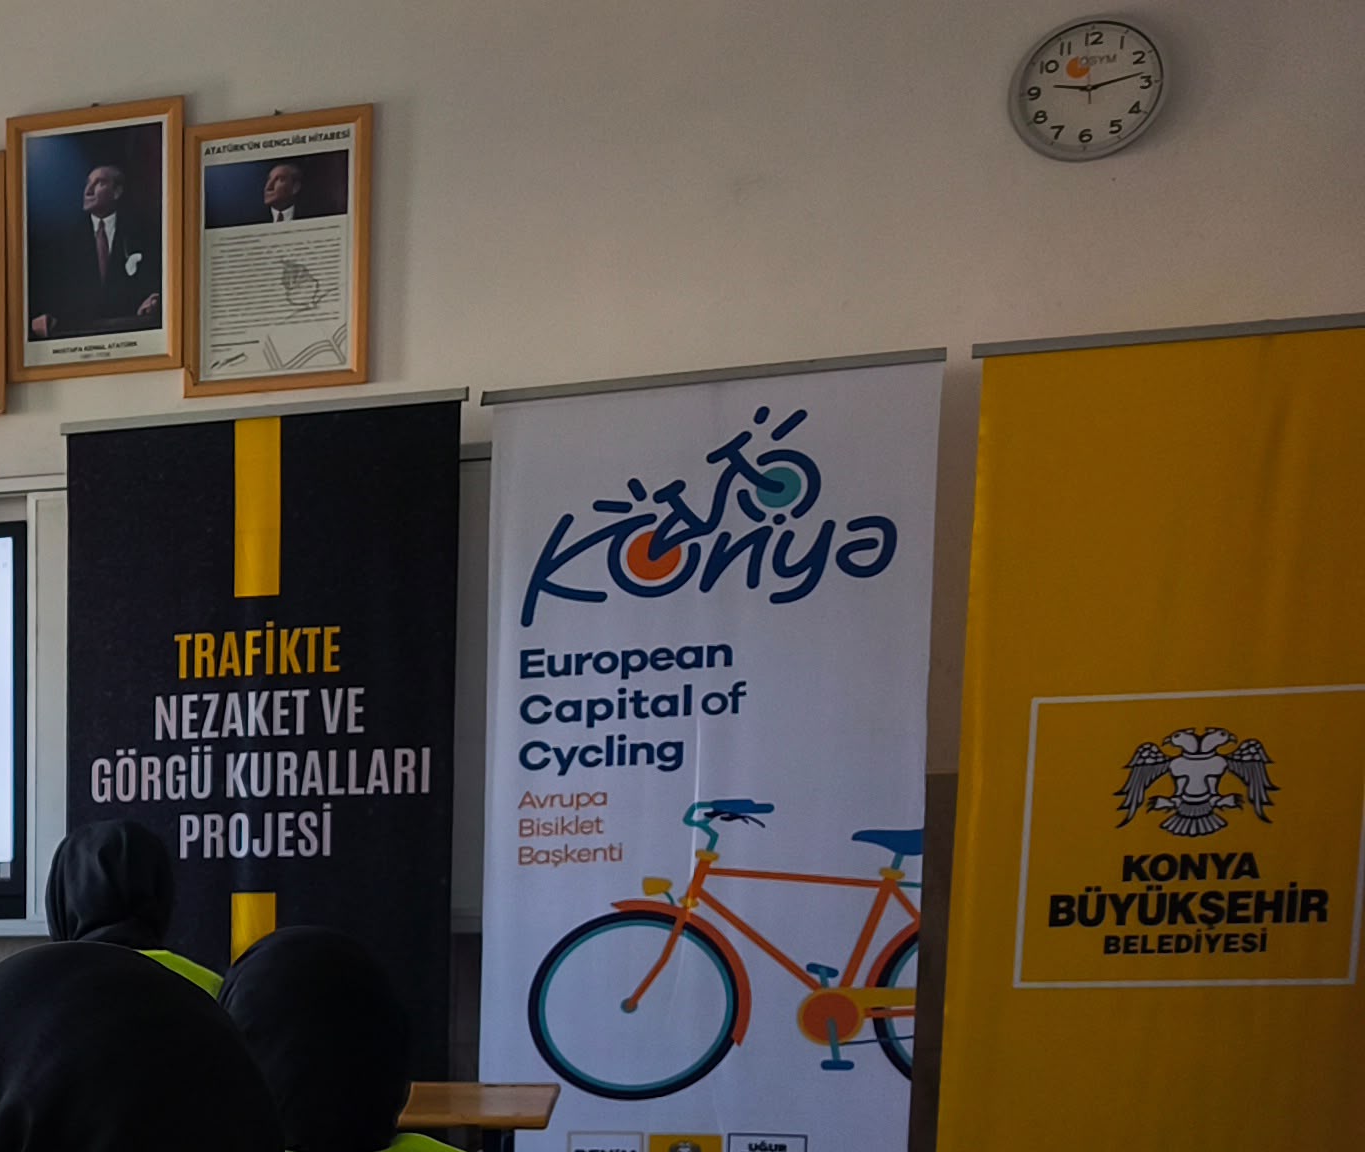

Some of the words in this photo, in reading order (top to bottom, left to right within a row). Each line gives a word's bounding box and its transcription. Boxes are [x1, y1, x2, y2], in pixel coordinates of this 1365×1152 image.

[1060, 41, 1071, 56] 11
[1085, 32, 1103, 46] 12
[1120, 35, 1125, 50] 1
[1040, 60, 1059, 74] 10
[1132, 50, 1146, 65] 2
[1139, 75, 1152, 89] 3
[1027, 86, 1041, 101] 9
[1033, 110, 1048, 124] 8
[1128, 101, 1141, 114] 4
[1051, 125, 1065, 140] 7
[1078, 129, 1093, 143] 6
[1109, 119, 1122, 134] 5
[174, 621, 341, 679] TRAFİKTE
[519, 643, 733, 680] European
[154, 688, 310, 741] NEZAKET
[320, 687, 365, 735] VE
[519, 684, 693, 729] Capital
[701, 681, 747, 716] of
[519, 735, 684, 776] Cycling
[91, 746, 212, 803] GÖRGÜ
[226, 747, 431, 798] KURALLARI
[518, 789, 608, 811] Avrupa
[179, 803, 332, 860] PROJESİ
[518, 815, 604, 838] Bisiklet
[517, 842, 623, 867] Başkenti
[1122, 852, 1260, 882] KONYA
[1048, 882, 1329, 930] BÜYÜKŞEHİR
[1103, 928, 1267, 955] BELEDİYESİ
